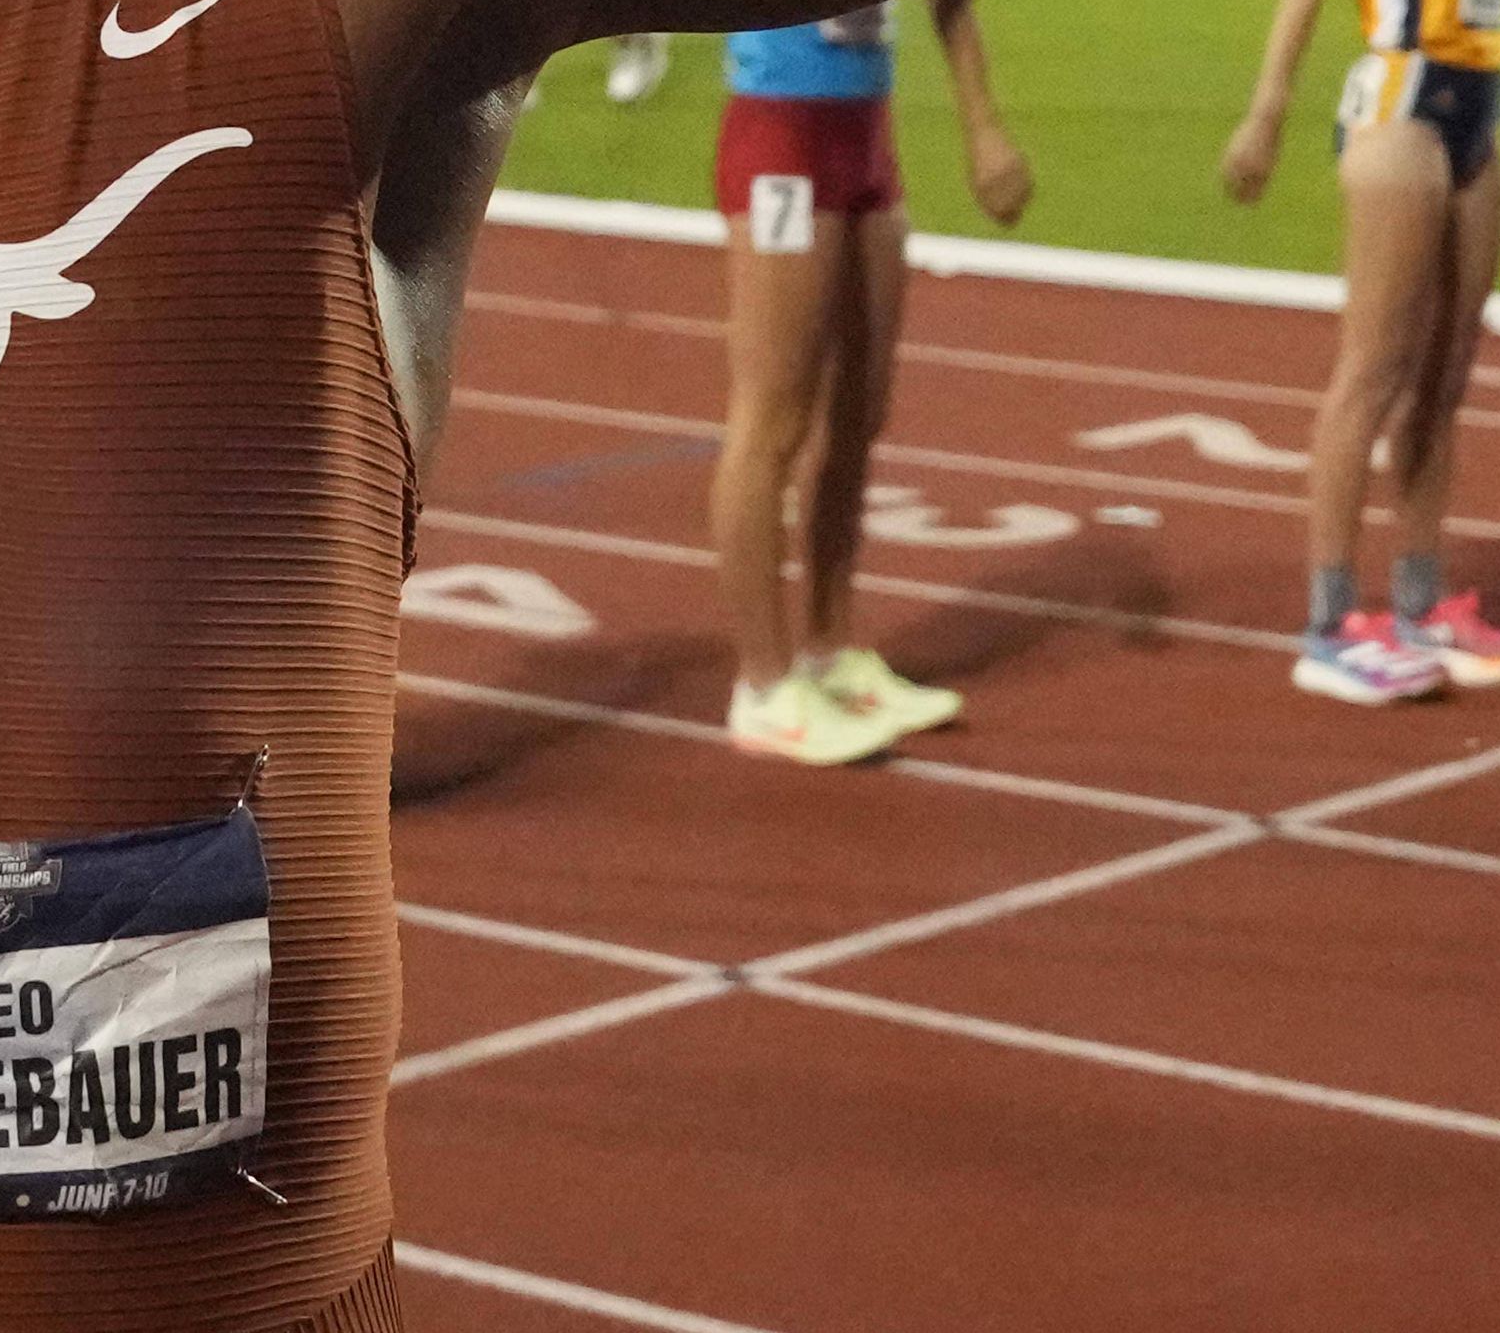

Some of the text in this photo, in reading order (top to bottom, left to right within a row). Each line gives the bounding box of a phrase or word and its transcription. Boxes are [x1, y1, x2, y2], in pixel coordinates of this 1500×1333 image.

[769, 183, 794, 239] 7
[2, 862, 26, 873] FIELD
[123, 1171, 168, 1200] 7-10
